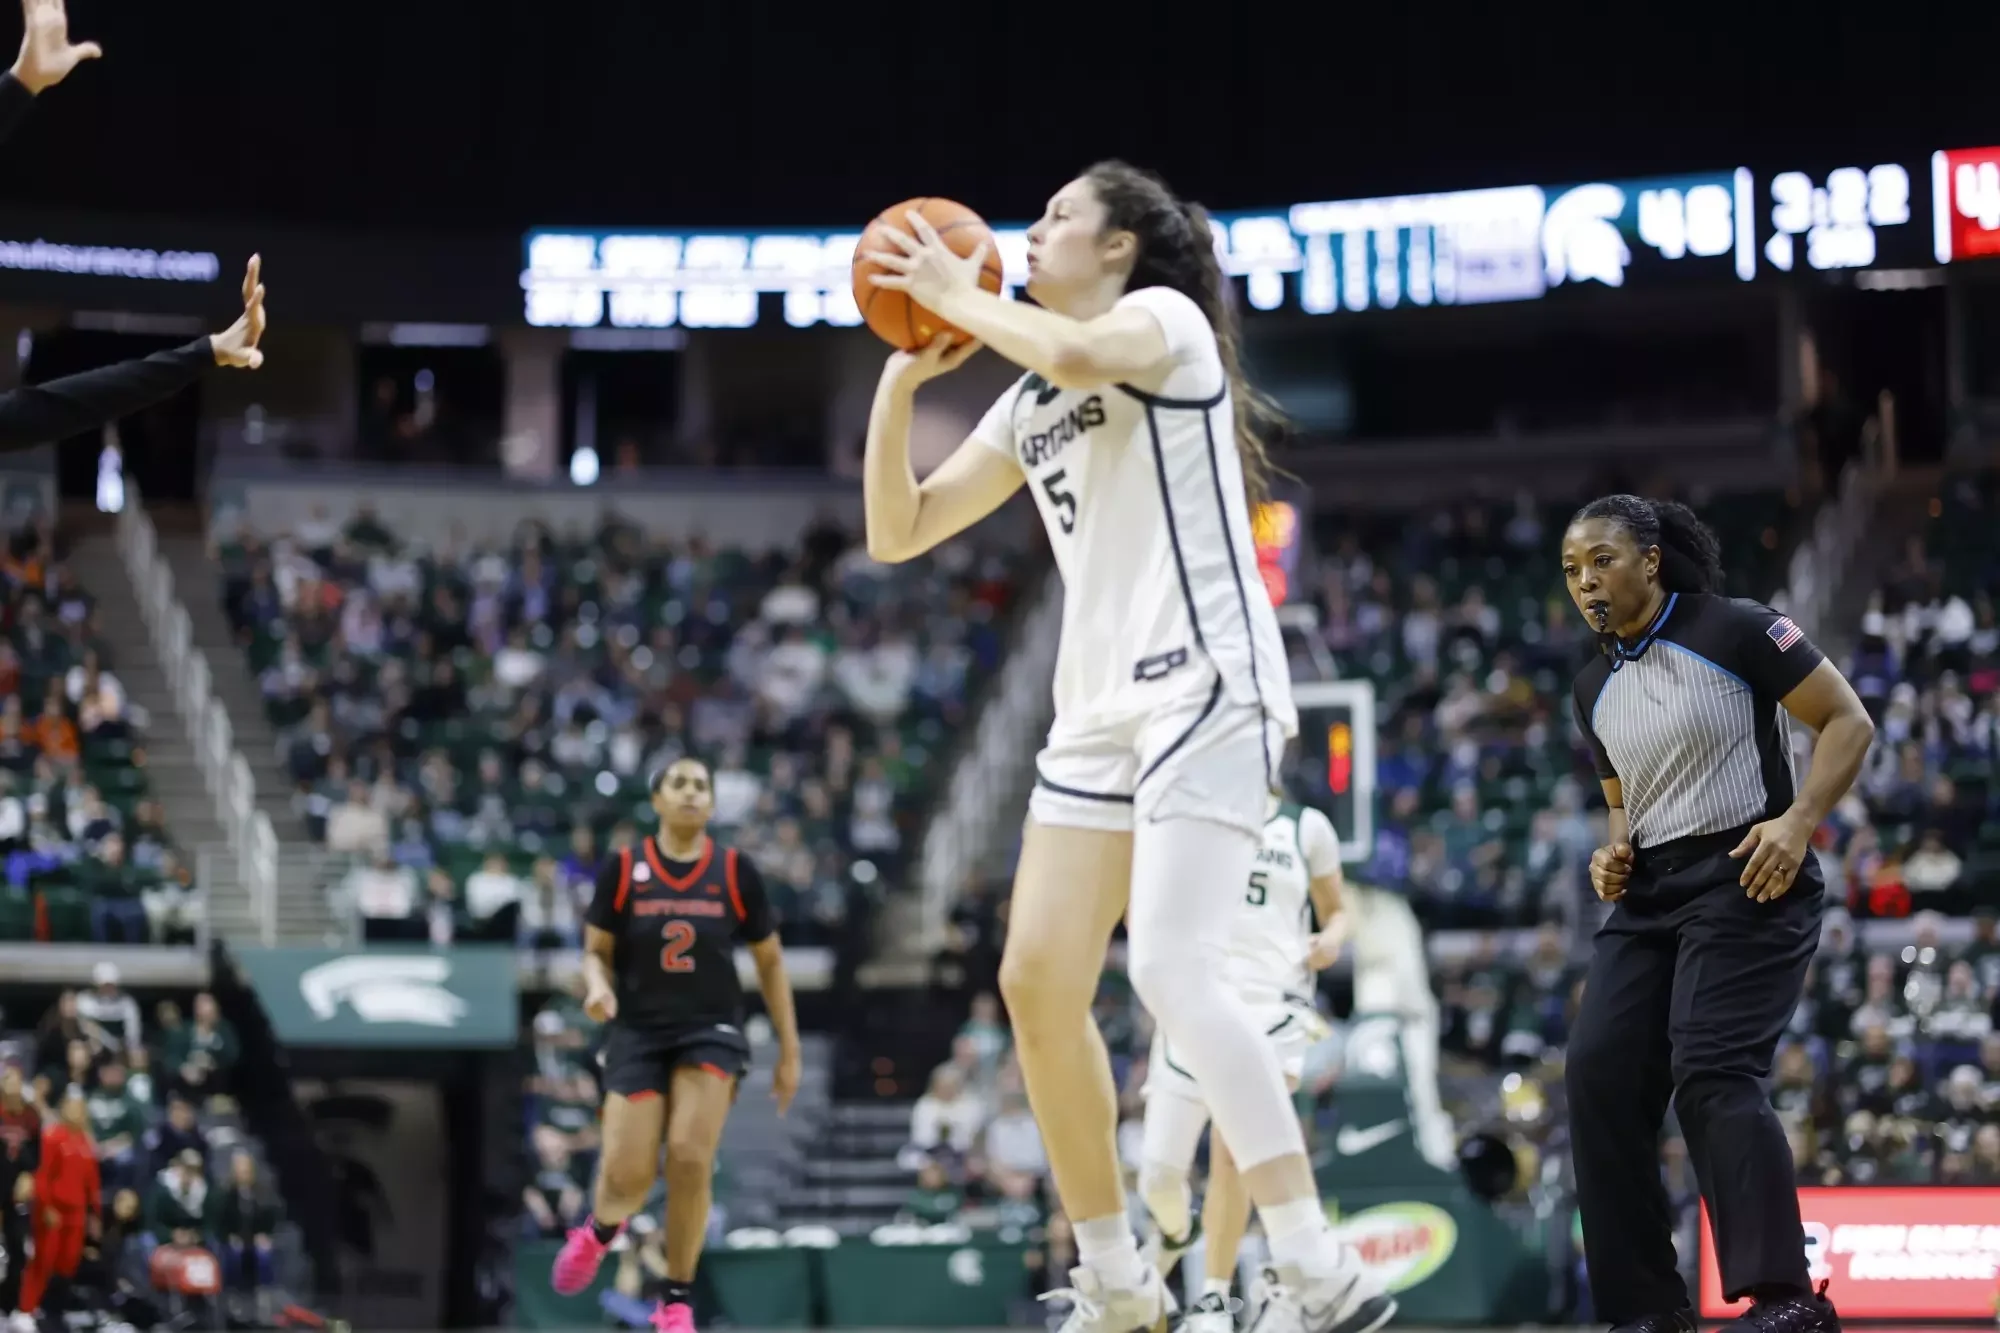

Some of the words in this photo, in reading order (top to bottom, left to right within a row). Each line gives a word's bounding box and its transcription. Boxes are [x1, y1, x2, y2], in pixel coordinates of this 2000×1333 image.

[1043, 469, 1076, 534] 5
[1246, 871, 1268, 906] 5
[661, 919, 697, 973] 2
